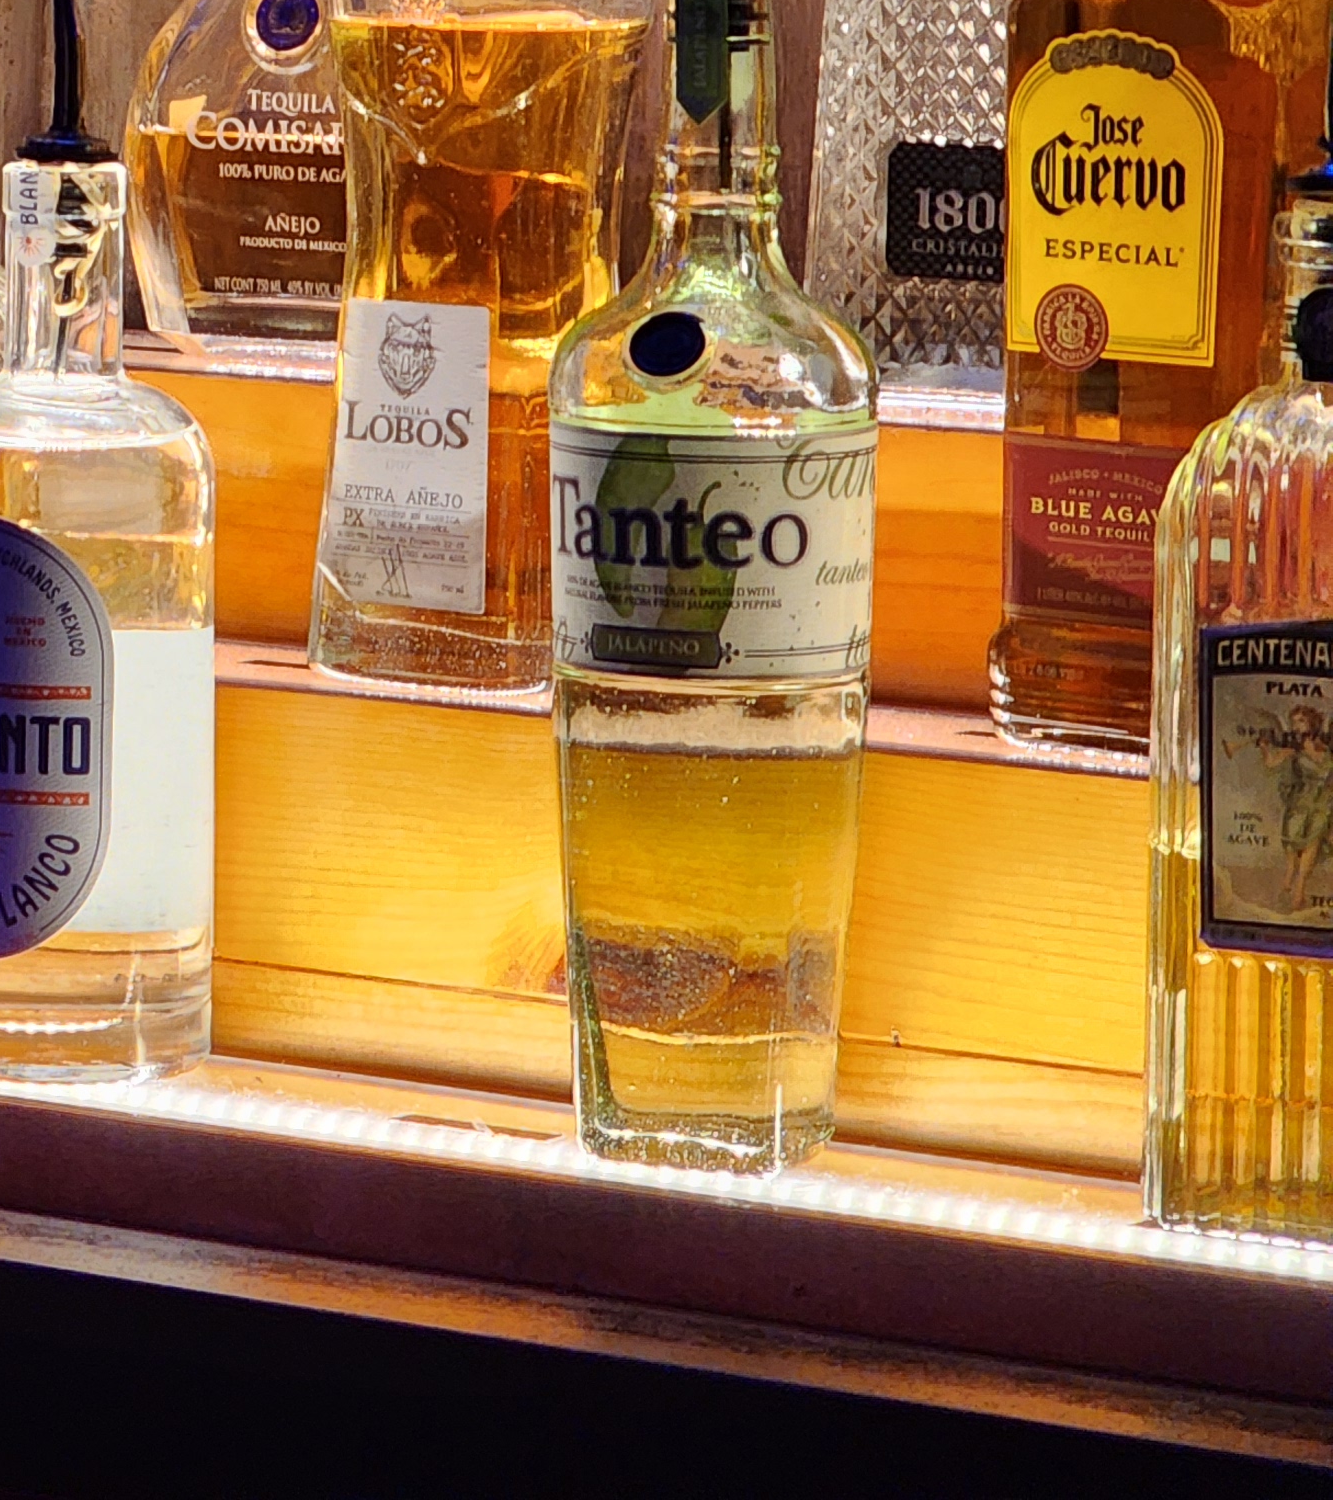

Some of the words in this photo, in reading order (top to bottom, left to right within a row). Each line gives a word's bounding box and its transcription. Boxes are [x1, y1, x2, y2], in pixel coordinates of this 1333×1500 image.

[247, 88, 335, 116] TEQUILA
[186, 111, 345, 155] COMISAR
[1080, 103, 1145, 152] Jose
[219, 163, 252, 179] 100%
[254, 164, 294, 181] PURO
[298, 167, 317, 181] DE
[1031, 131, 1187, 216] Cuervo
[19, 171, 39, 225] BLAN
[265, 213, 321, 237] AÑEJO
[240, 236, 292, 249] PRODUCTO
[911, 238, 1004, 257] CRISTALI
[1045, 238, 1179, 268] ESPECIAL
[380, 404, 431, 416] TEQUILA
[344, 400, 471, 450] LOBOS
[1049, 469, 1099, 485] JALISCO
[1113, 472, 1163, 496] MEXICO
[344, 483, 395, 504] EXTRA
[408, 486, 463, 510] AÑEJO
[343, 507, 365, 528] PX
[552, 473, 810, 571] Tanteo
[1031, 497, 1092, 519] BLUE
[1101, 504, 1160, 526] AGAV
[1049, 521, 1090, 536] GOLD
[1097, 526, 1151, 542] TEQUIL
[746, 586, 776, 597] WITH
[55, 601, 86, 657] MEXICO
[4, 638, 48, 648] MEXICO
[1217, 637, 1333, 668] CENTENA
[1266, 681, 1323, 698] PLATA
[1227, 834, 1270, 848] AGAVE
